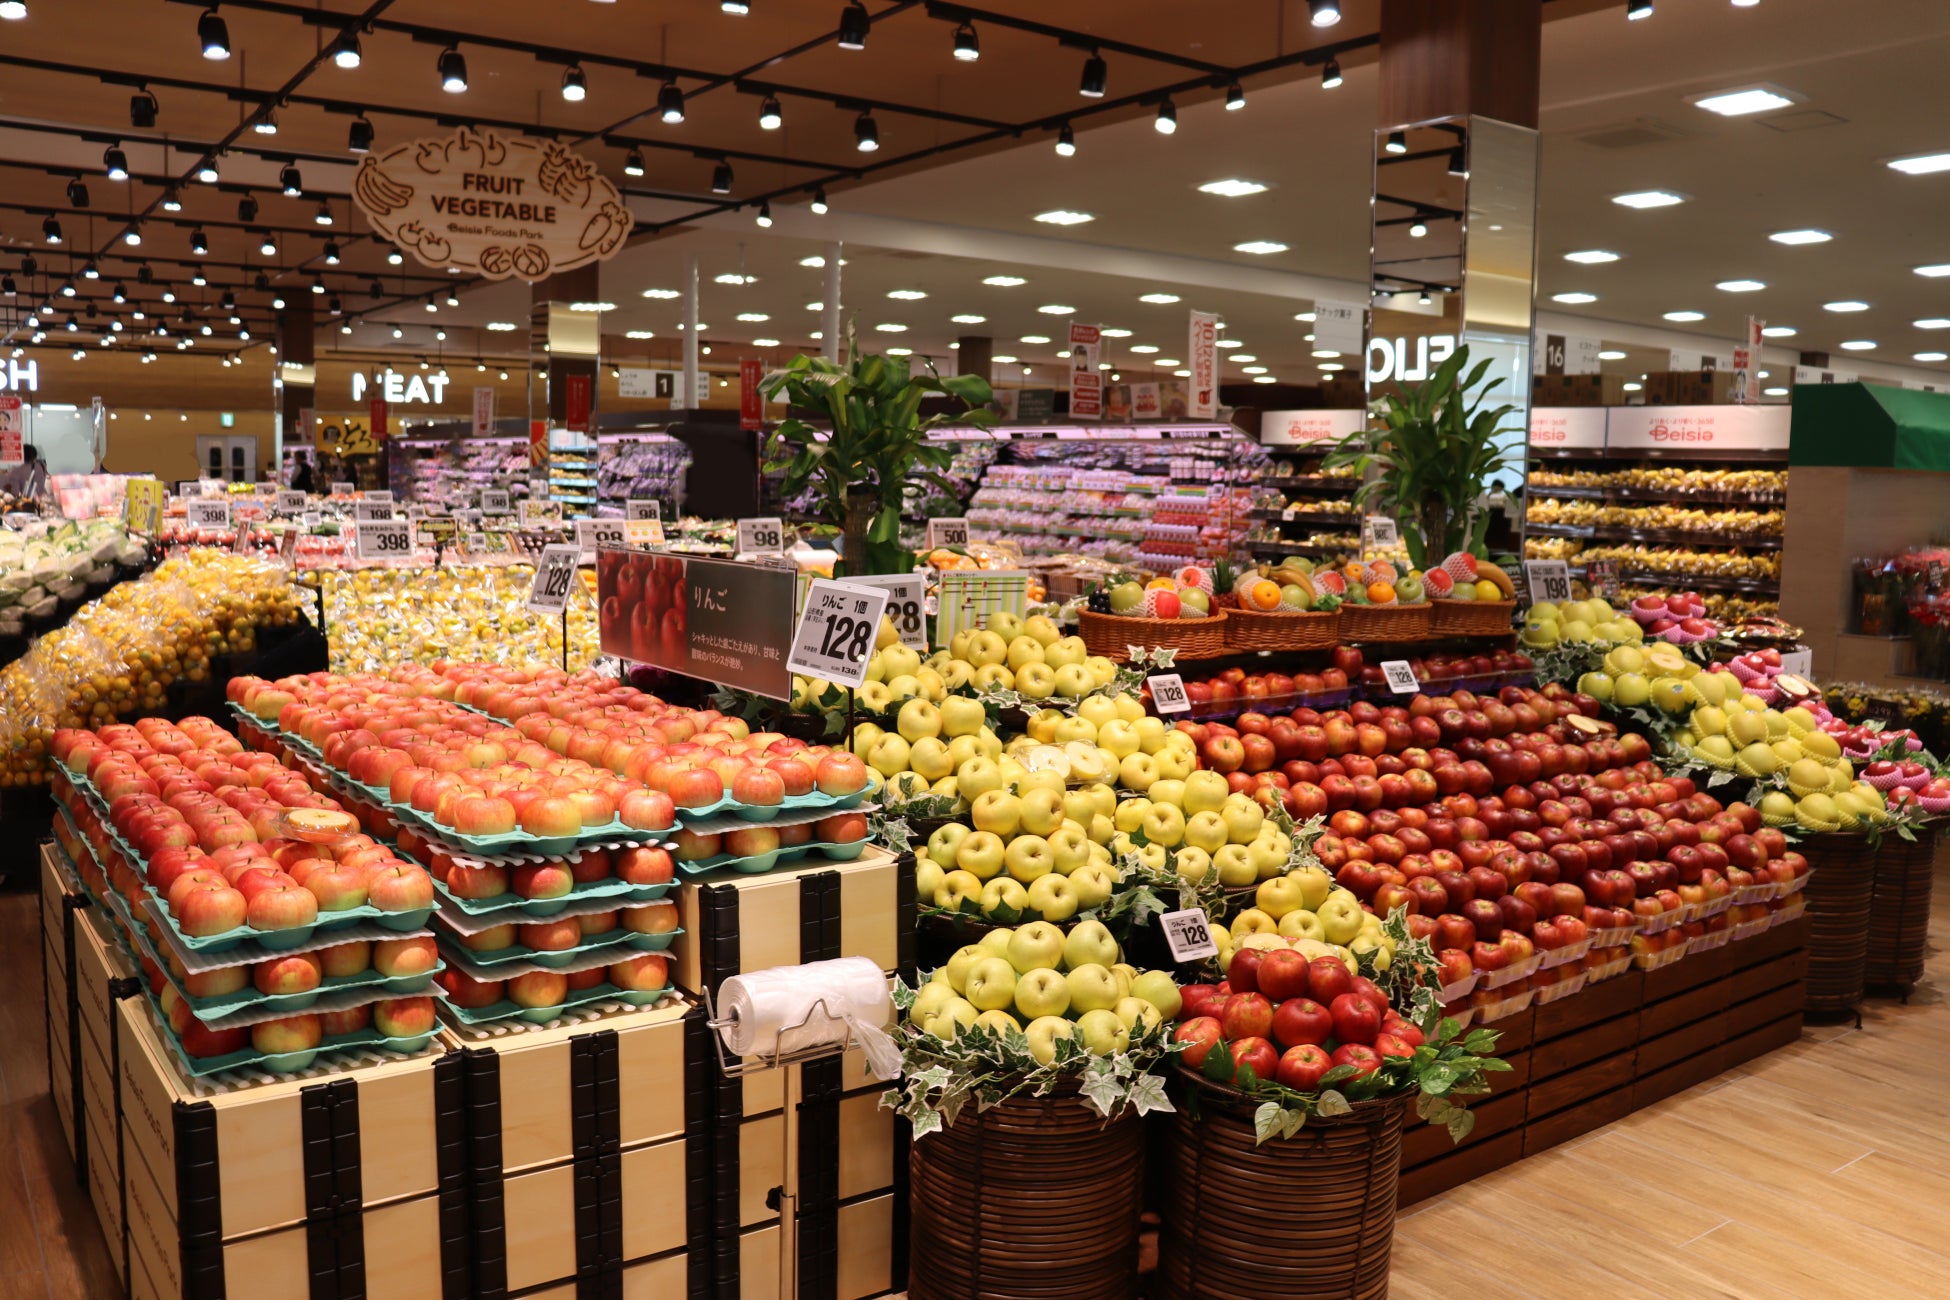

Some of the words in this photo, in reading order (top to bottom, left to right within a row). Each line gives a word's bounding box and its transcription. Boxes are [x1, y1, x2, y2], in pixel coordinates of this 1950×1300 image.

[463, 173, 525, 195] FRUIT
[431, 195, 556, 223] VEGETABLE
[447, 222, 482, 234] Beisia
[485, 226, 518, 238] Foods
[520, 229, 543, 239] Park
[1548, 345, 1563, 367] 16
[660, 378, 667, 394] 1
[1529, 425, 1567, 441] eisia
[1648, 425, 1714, 441] Beisia
[202, 510, 226, 522] 398
[371, 509, 391, 520] 198
[639, 509, 657, 519] 98
[377, 533, 410, 551] 398
[595, 531, 623, 542] 98
[754, 531, 780, 546] 98
[944, 530, 967, 544] 500
[544, 568, 572, 597] 128
[1543, 577, 1569, 599] 198
[694, 586, 728, 612] りんご
[894, 587, 908, 598] 1個
[822, 594, 847, 610] りんご
[854, 600, 868, 615] 1個
[884, 601, 921, 634] 28
[820, 614, 872, 662] 128
[841, 666, 857, 675] 138
[1396, 671, 1412, 683] 128
[1163, 687, 1183, 701] 128
[1181, 925, 1209, 946] 128
